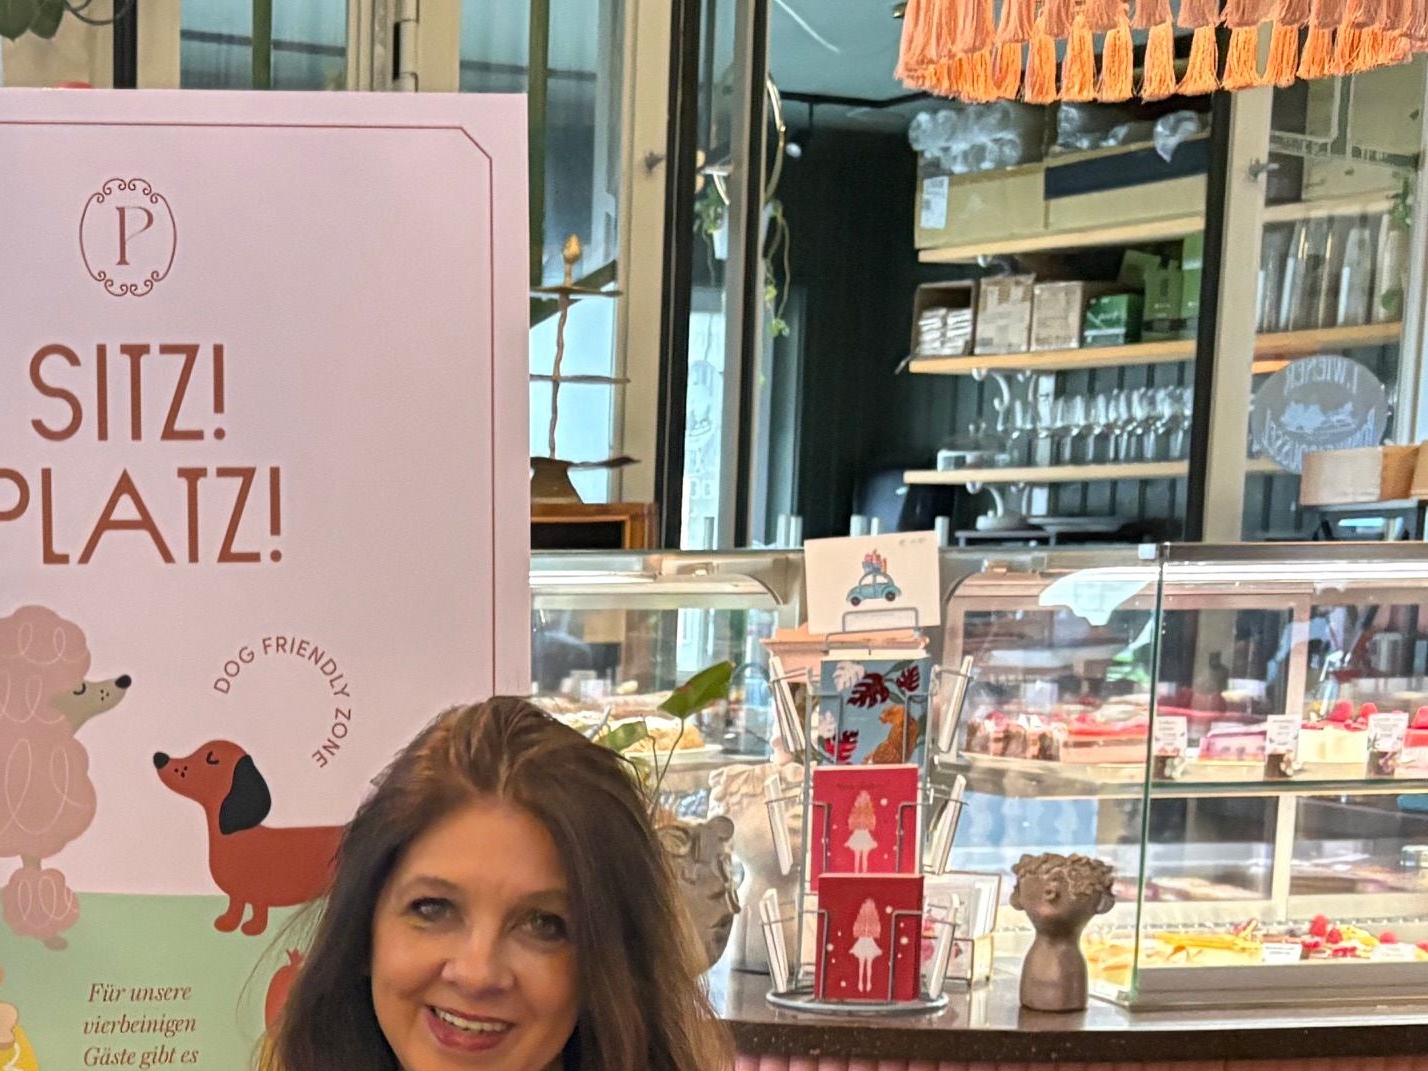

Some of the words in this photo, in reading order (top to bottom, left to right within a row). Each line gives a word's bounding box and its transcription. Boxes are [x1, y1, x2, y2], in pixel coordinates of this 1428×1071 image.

[115, 206, 154, 266] P
[29, 343, 226, 442] SITZ!
[213, 646, 255, 694] DOG
[262, 636, 351, 697] FRIENDLY
[311, 707, 352, 768] ZONE
[88, 983, 126, 1003] Für
[130, 985, 192, 1002] unsere
[83, 1013, 196, 1038] vierbeinigen
[83, 1046, 136, 1067] Gäste
[139, 1044, 176, 1070] gibt
[180, 1049, 199, 1065] es
